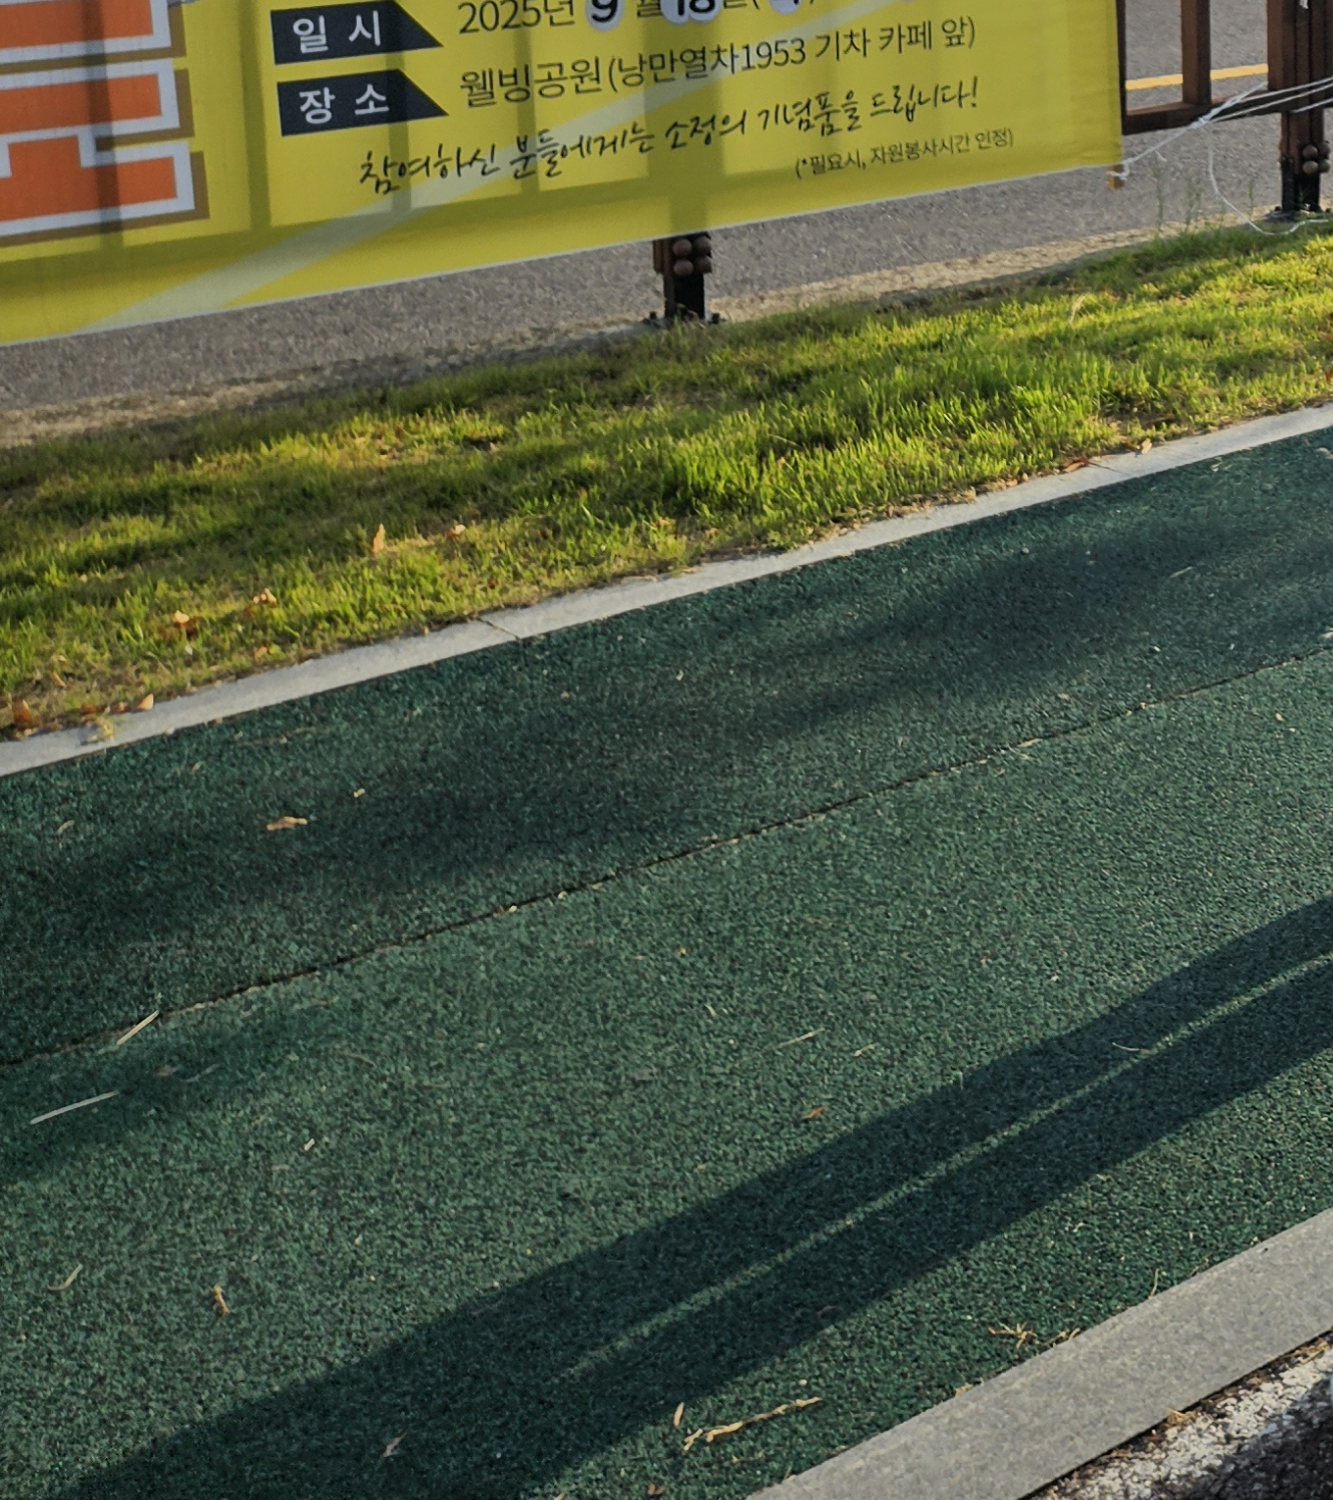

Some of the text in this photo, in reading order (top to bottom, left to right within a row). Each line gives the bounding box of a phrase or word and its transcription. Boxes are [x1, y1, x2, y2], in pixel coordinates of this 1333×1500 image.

[814, 28, 872, 62] 기차
[879, 20, 933, 57] 카페
[940, 16, 976, 49] 앞)
[359, 76, 980, 196] 참여하신 분들에게는 소정의 기념품을 드립니다!
[870, 134, 971, 165] 자원봉사시간
[974, 127, 1015, 149] 인정)
